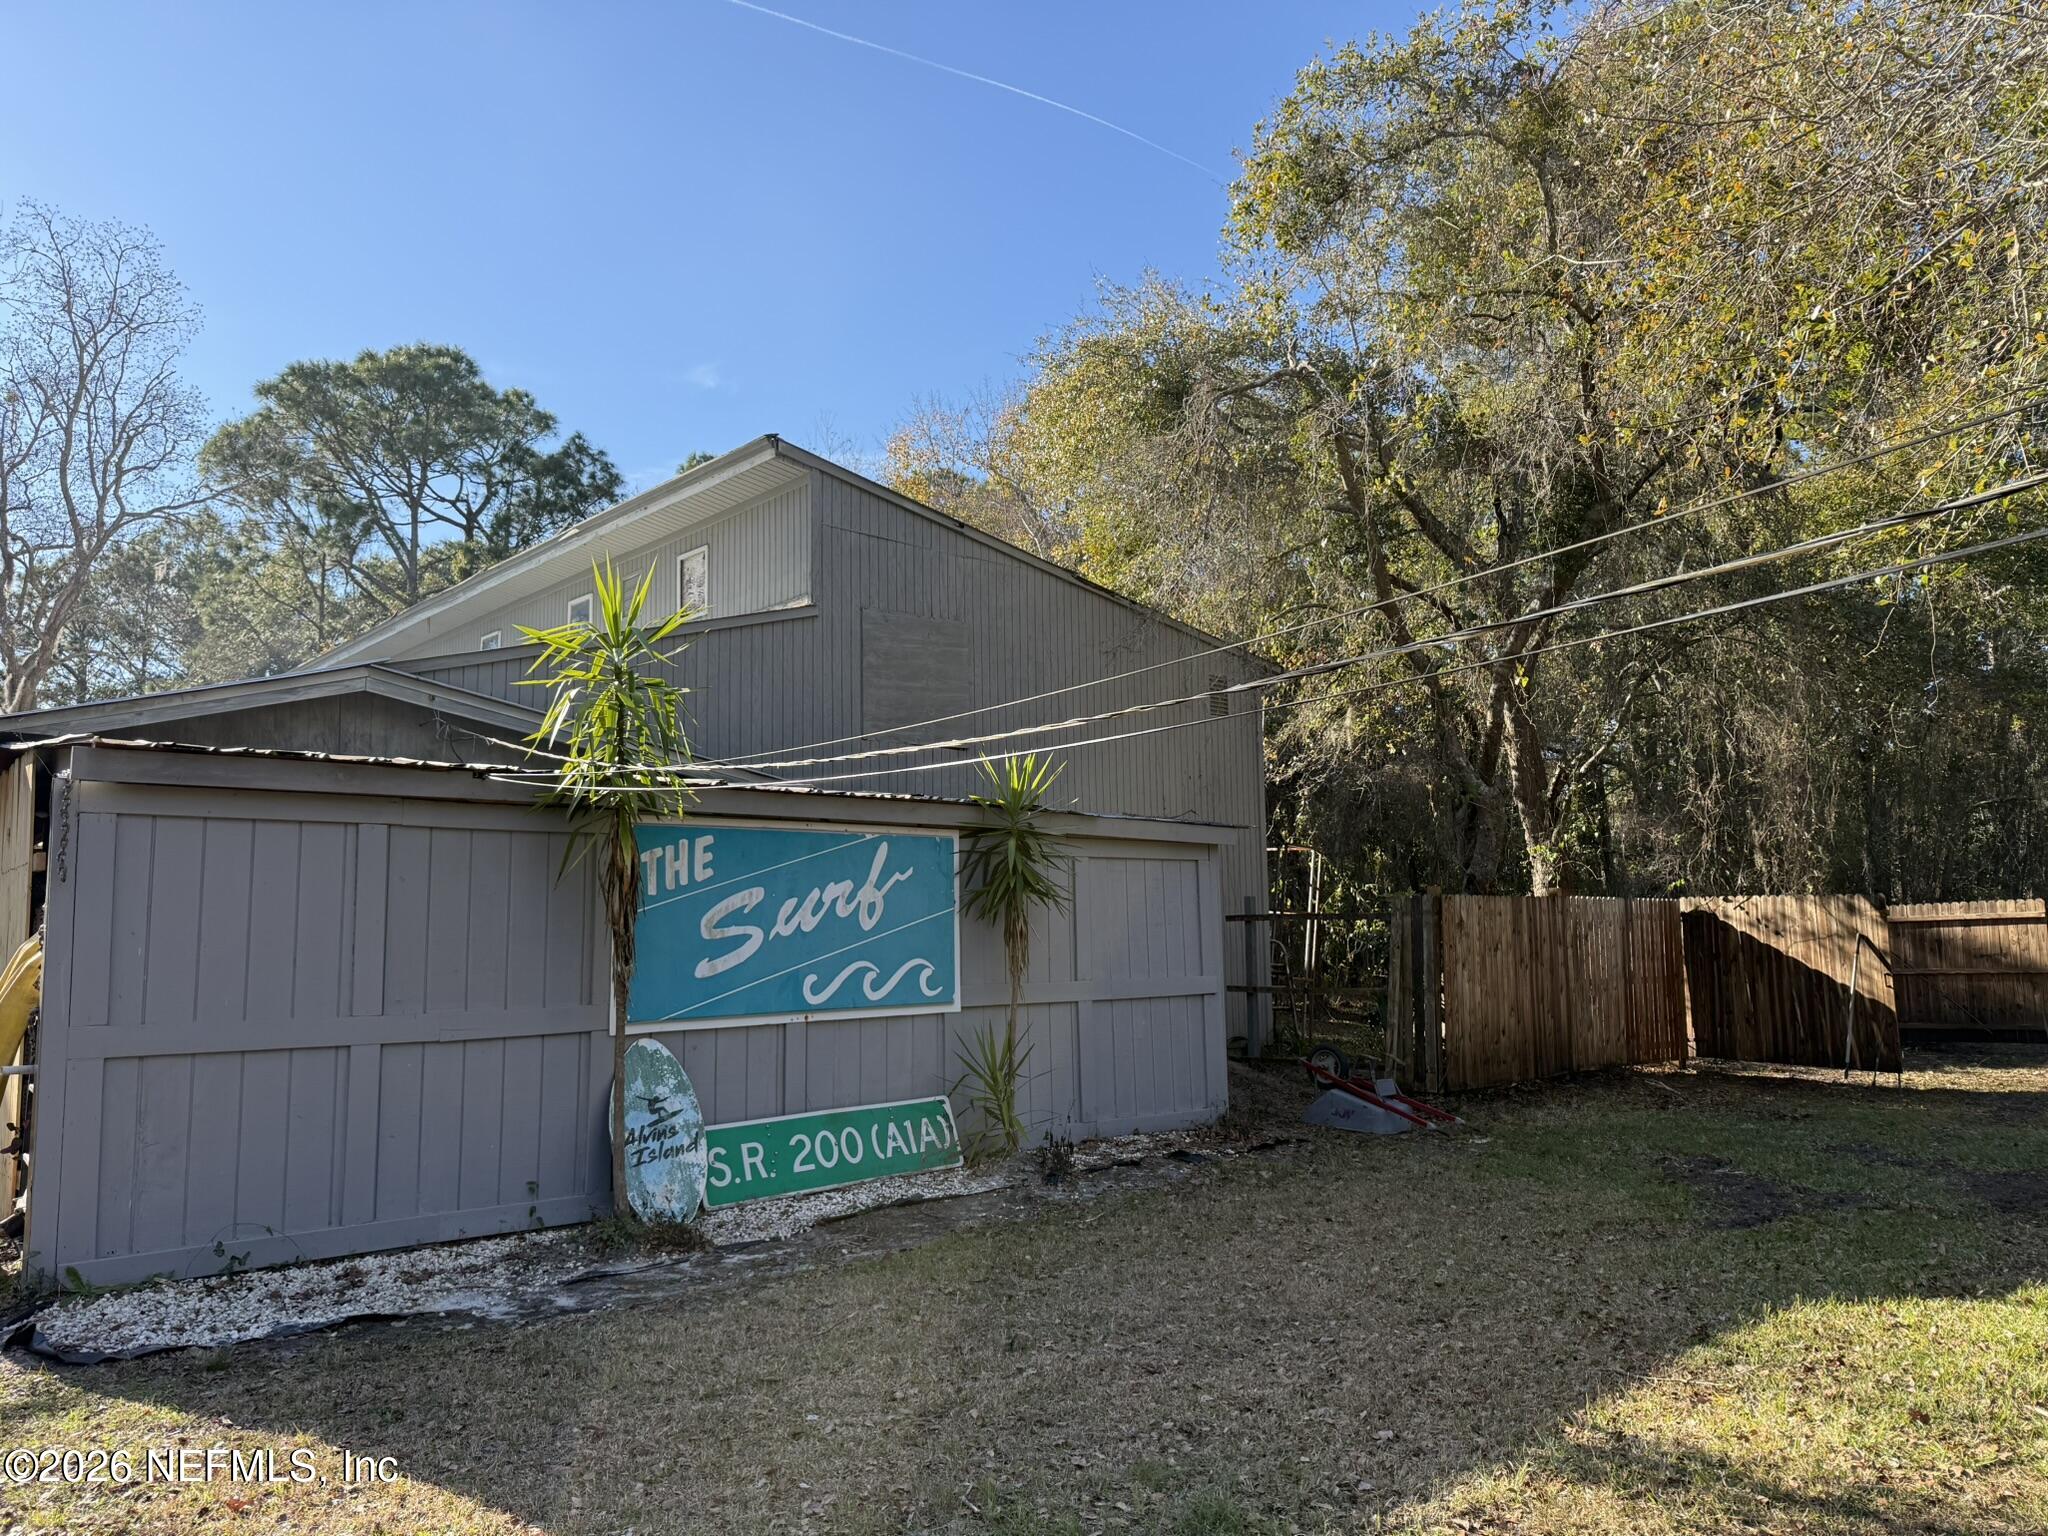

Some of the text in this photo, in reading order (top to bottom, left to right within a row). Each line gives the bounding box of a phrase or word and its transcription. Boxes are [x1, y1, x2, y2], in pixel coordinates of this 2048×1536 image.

[640, 835, 714, 896] THE
[694, 841, 913, 979] Surf
[630, 1130, 699, 1168] Island
[707, 1115, 951, 1188] S.R. 200 (A1A)
